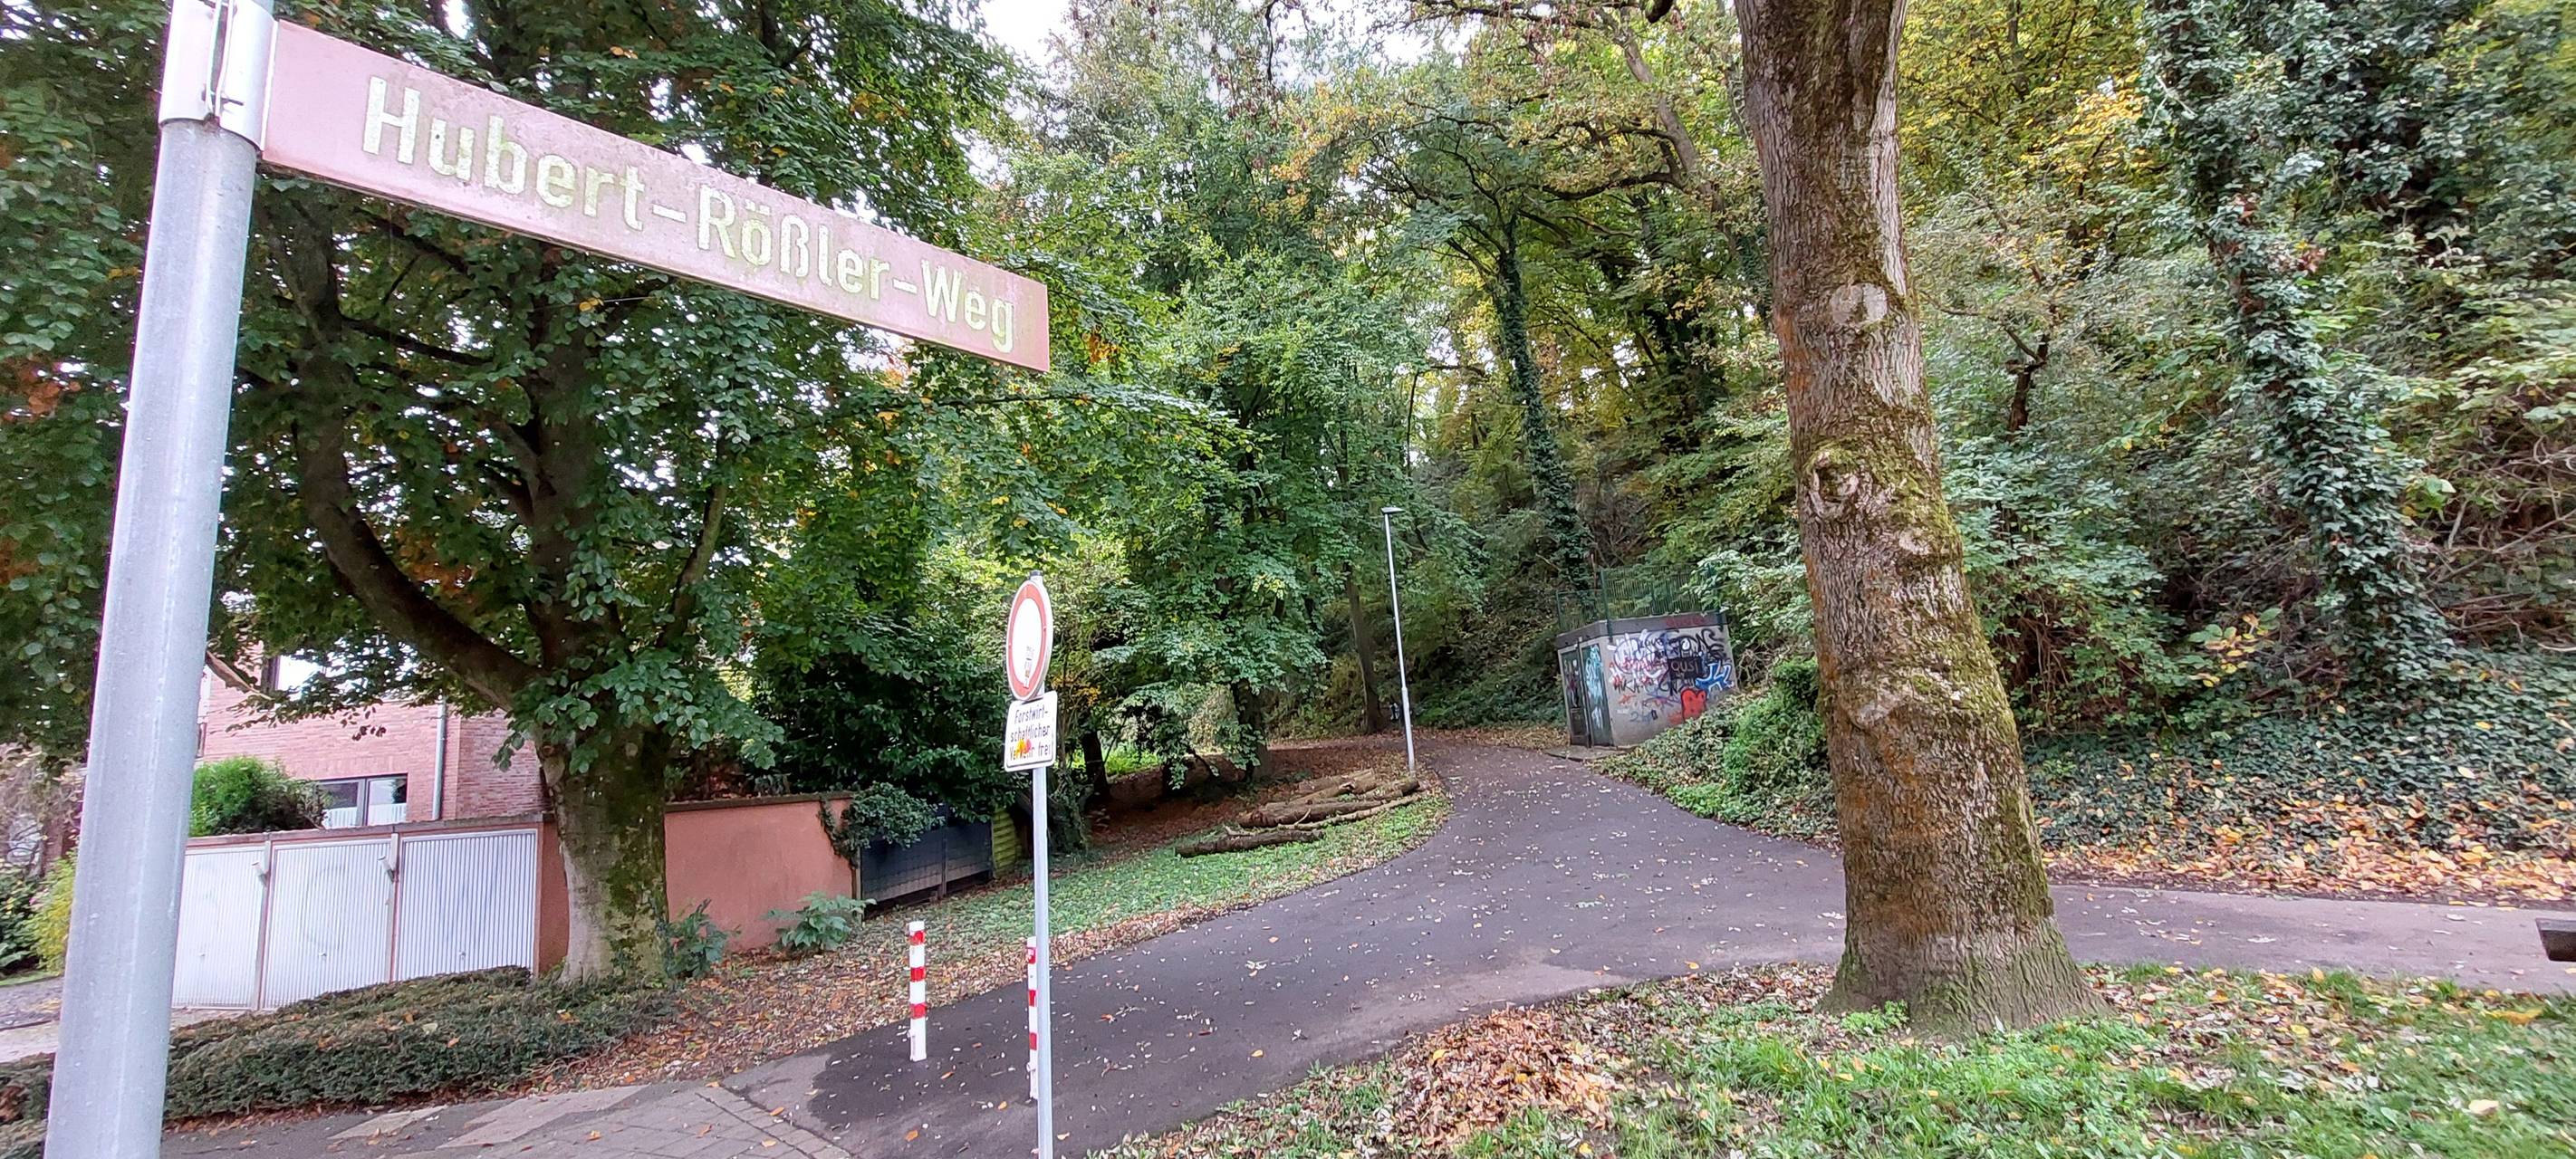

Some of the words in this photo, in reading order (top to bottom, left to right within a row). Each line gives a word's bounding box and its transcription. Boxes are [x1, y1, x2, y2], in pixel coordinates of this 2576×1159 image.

[362, 75, 1016, 353] Hubert-Rößler-Weg
[1014, 704, 1048, 723] Forstwirt-
[1010, 723, 1050, 742] schaftlicher
[1038, 742, 1051, 757] frei
